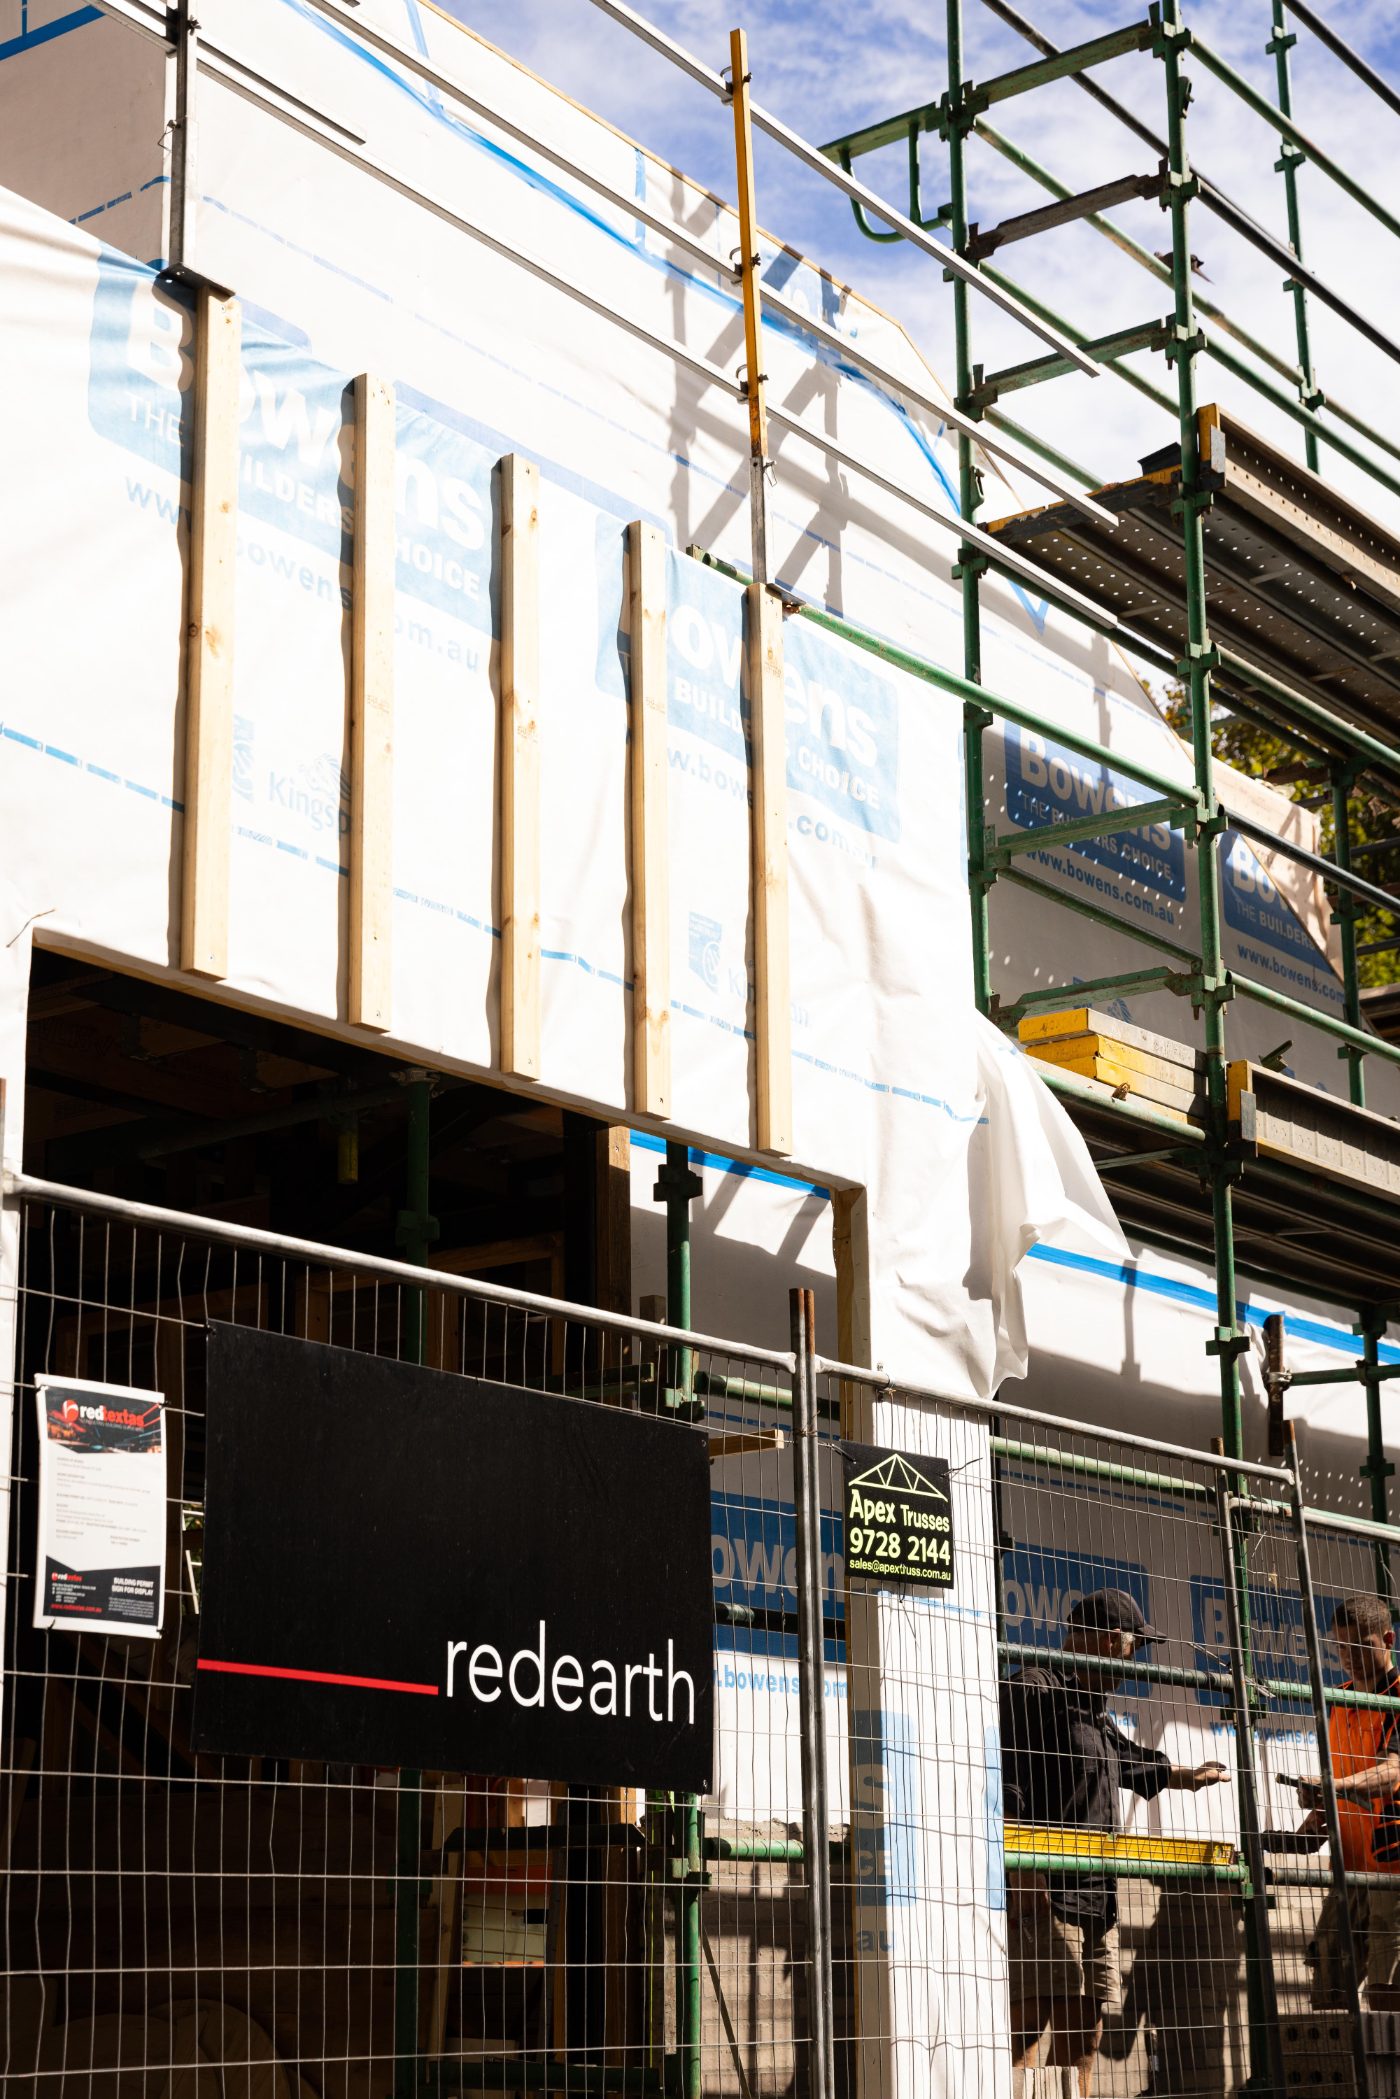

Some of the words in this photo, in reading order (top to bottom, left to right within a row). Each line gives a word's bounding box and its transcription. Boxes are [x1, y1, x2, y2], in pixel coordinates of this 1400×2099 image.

[849, 1488, 897, 1526] Apex
[899, 1503, 950, 1533] Trusses
[849, 1526, 901, 1559] 9728
[906, 1535, 951, 1566] 2144
[849, 1557, 952, 1582] sales@apextruss.com.au
[446, 1619, 695, 1725] redearth
